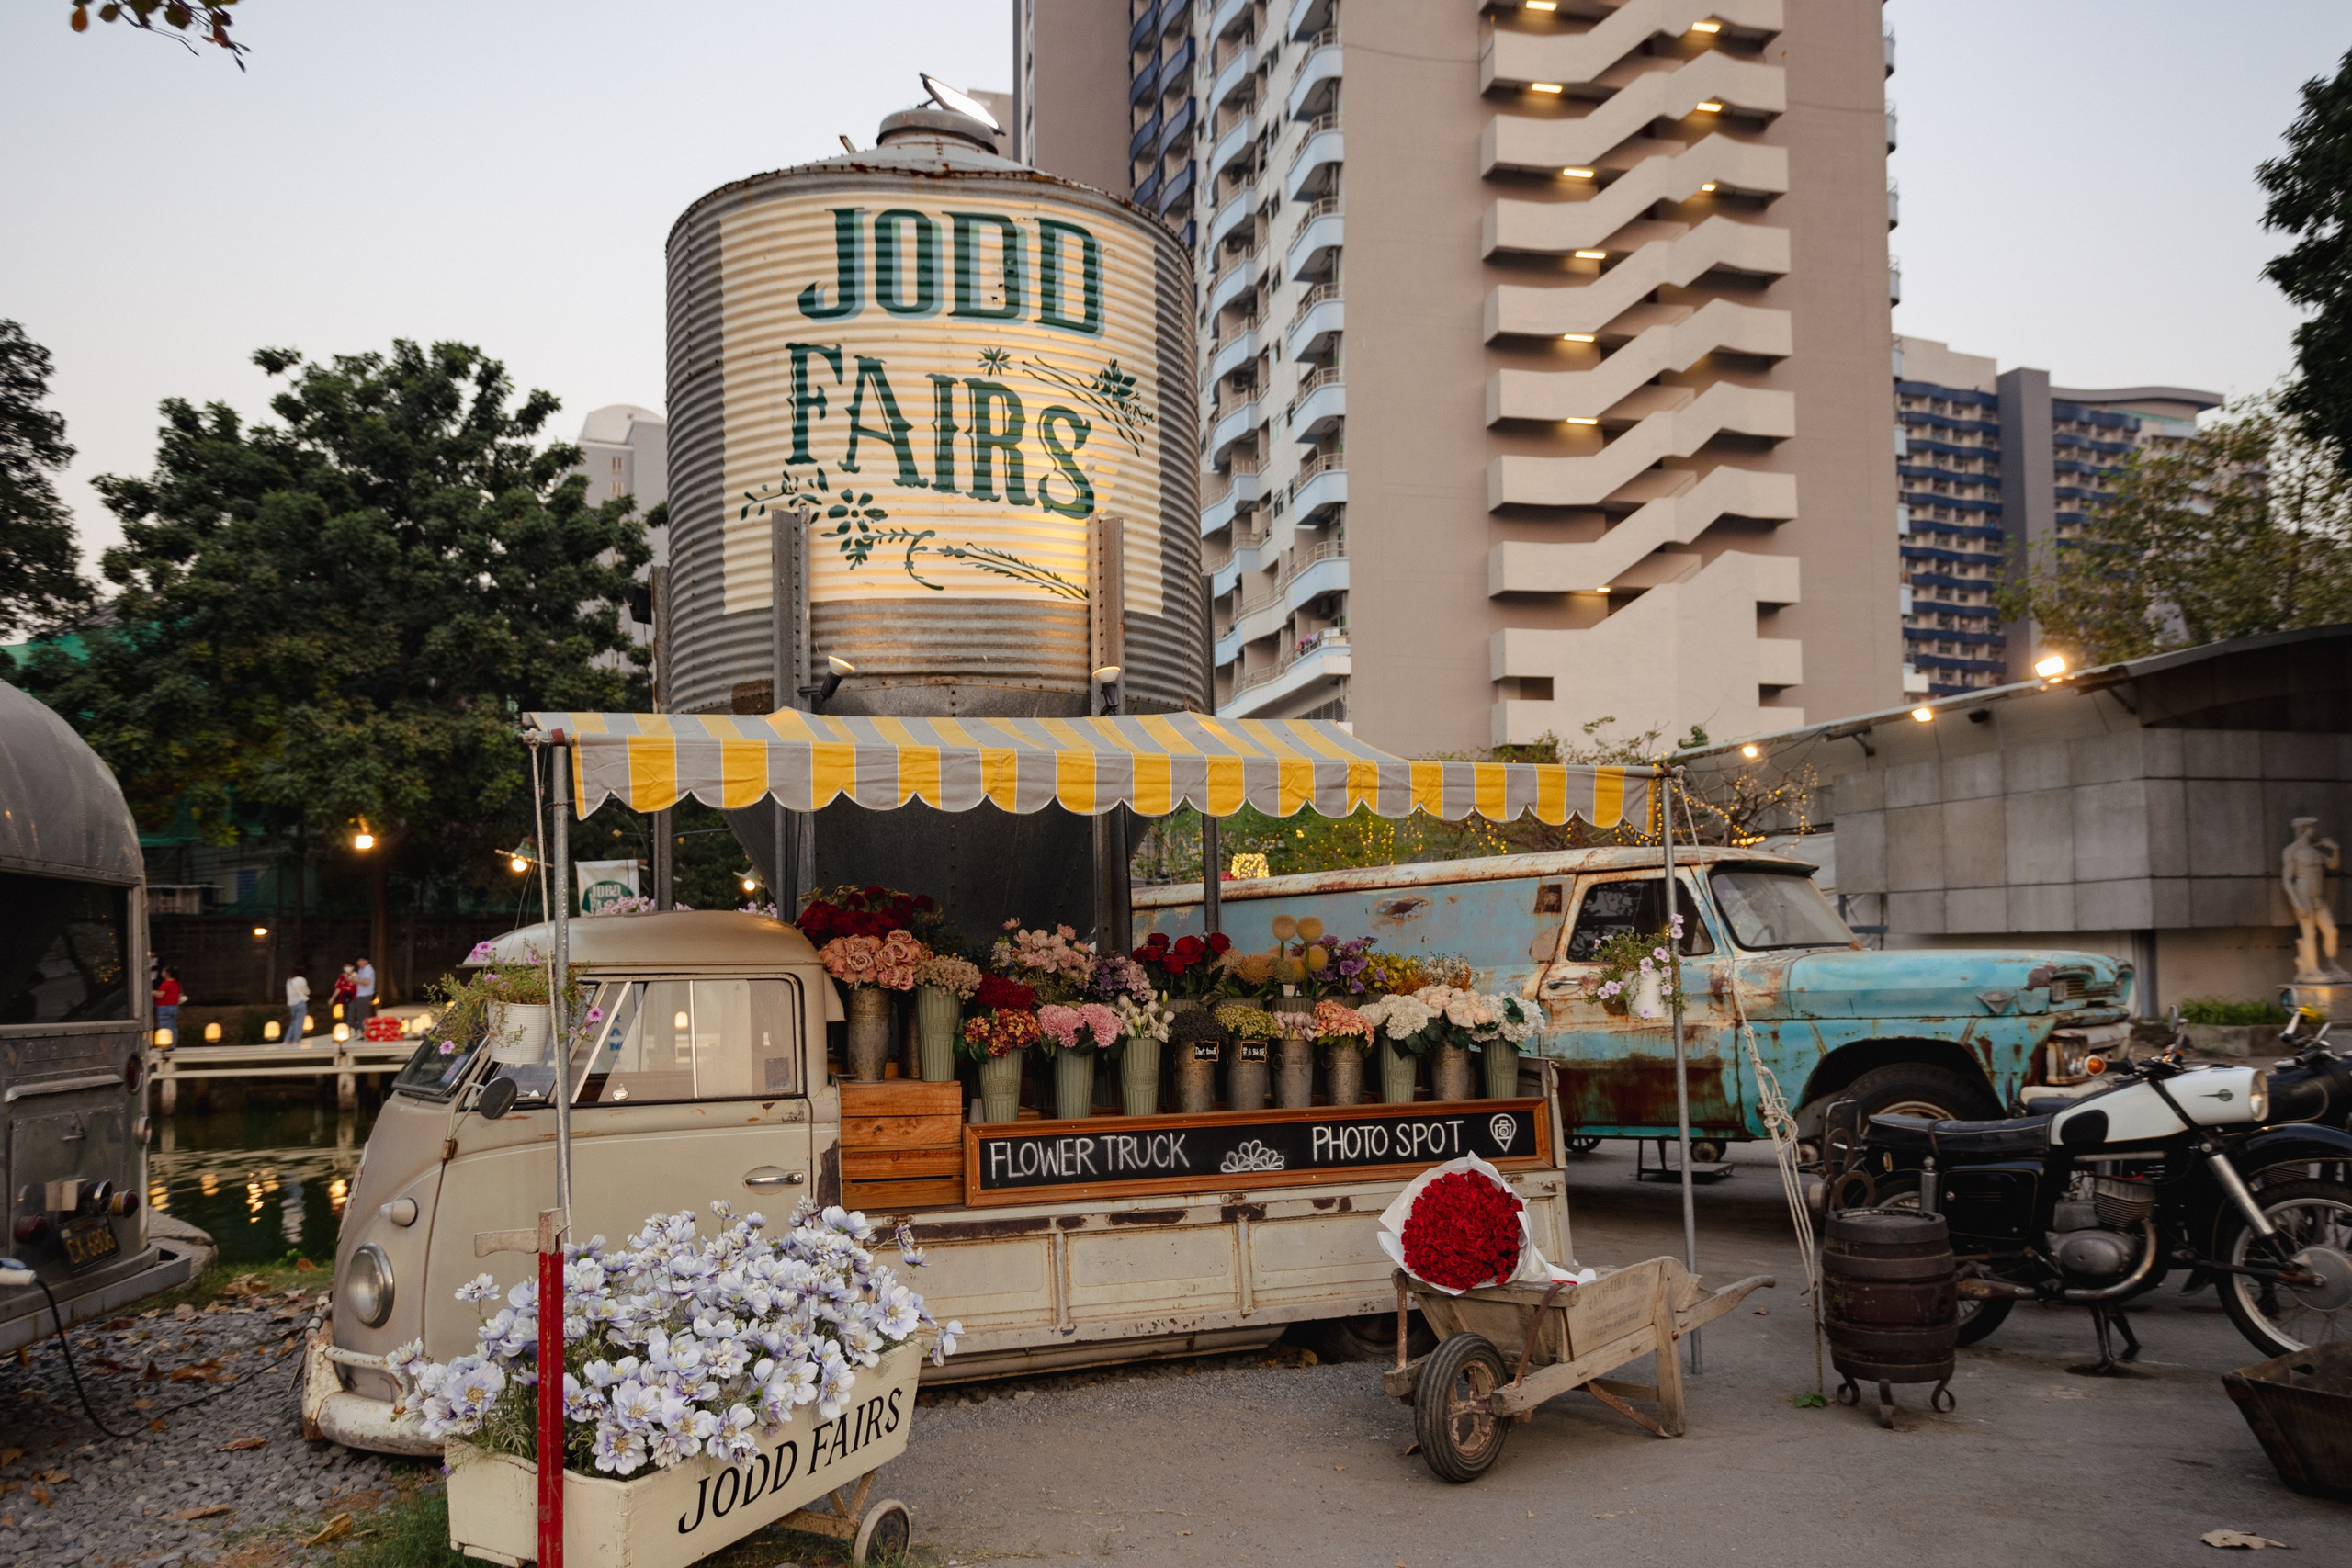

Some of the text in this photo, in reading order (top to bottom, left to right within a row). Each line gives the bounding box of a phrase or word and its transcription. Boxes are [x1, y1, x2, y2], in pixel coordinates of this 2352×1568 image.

[797, 207, 1104, 340] JODD
[785, 342, 1093, 520] FAIRS
[989, 1120, 1464, 1180] FLOWER TRUCK PHOTO SPOT
[678, 1387, 903, 1535] JODD FAIRS
